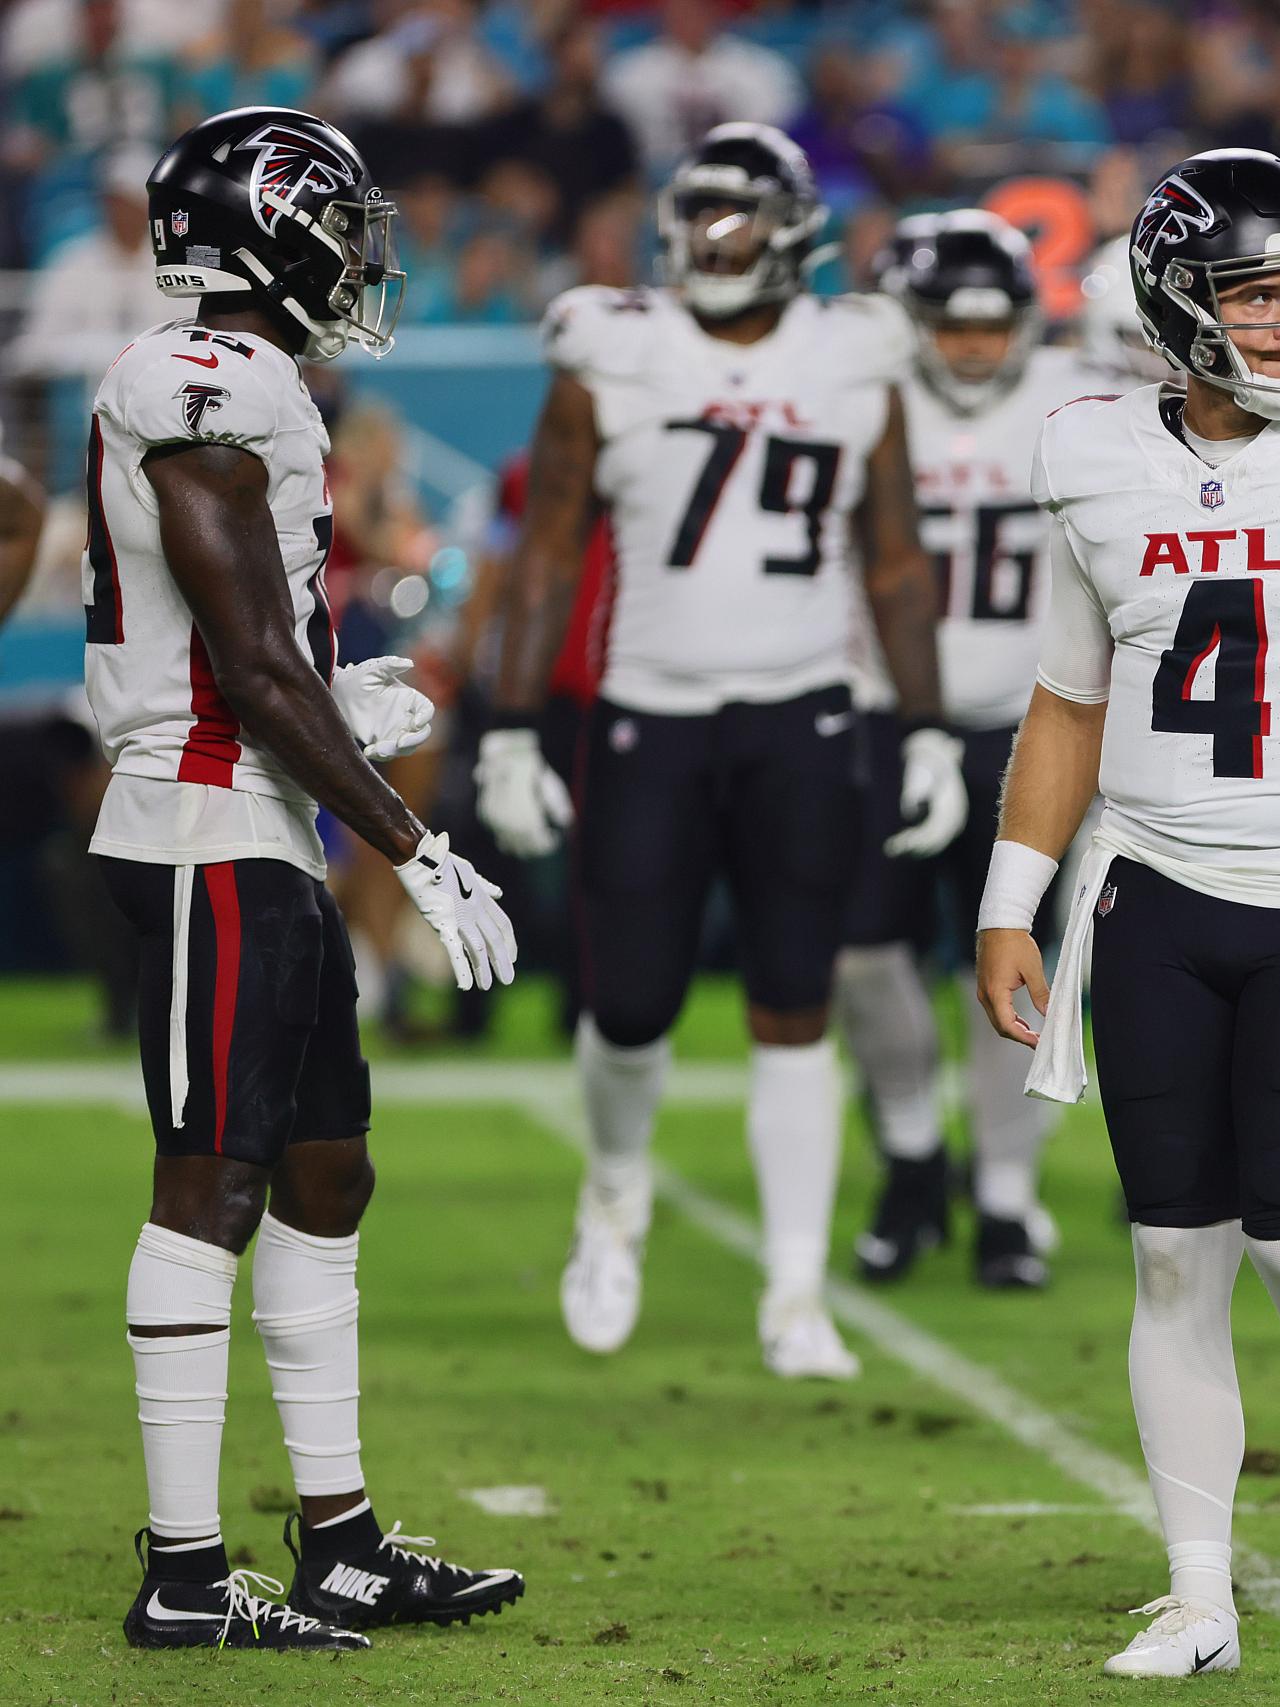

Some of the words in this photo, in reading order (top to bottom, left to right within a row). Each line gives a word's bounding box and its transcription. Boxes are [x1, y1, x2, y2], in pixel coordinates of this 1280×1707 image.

[150, 218, 167, 251] 9
[663, 419, 842, 576] 79
[1151, 577, 1272, 779] 4
[319, 1562, 391, 1606] NIKE
